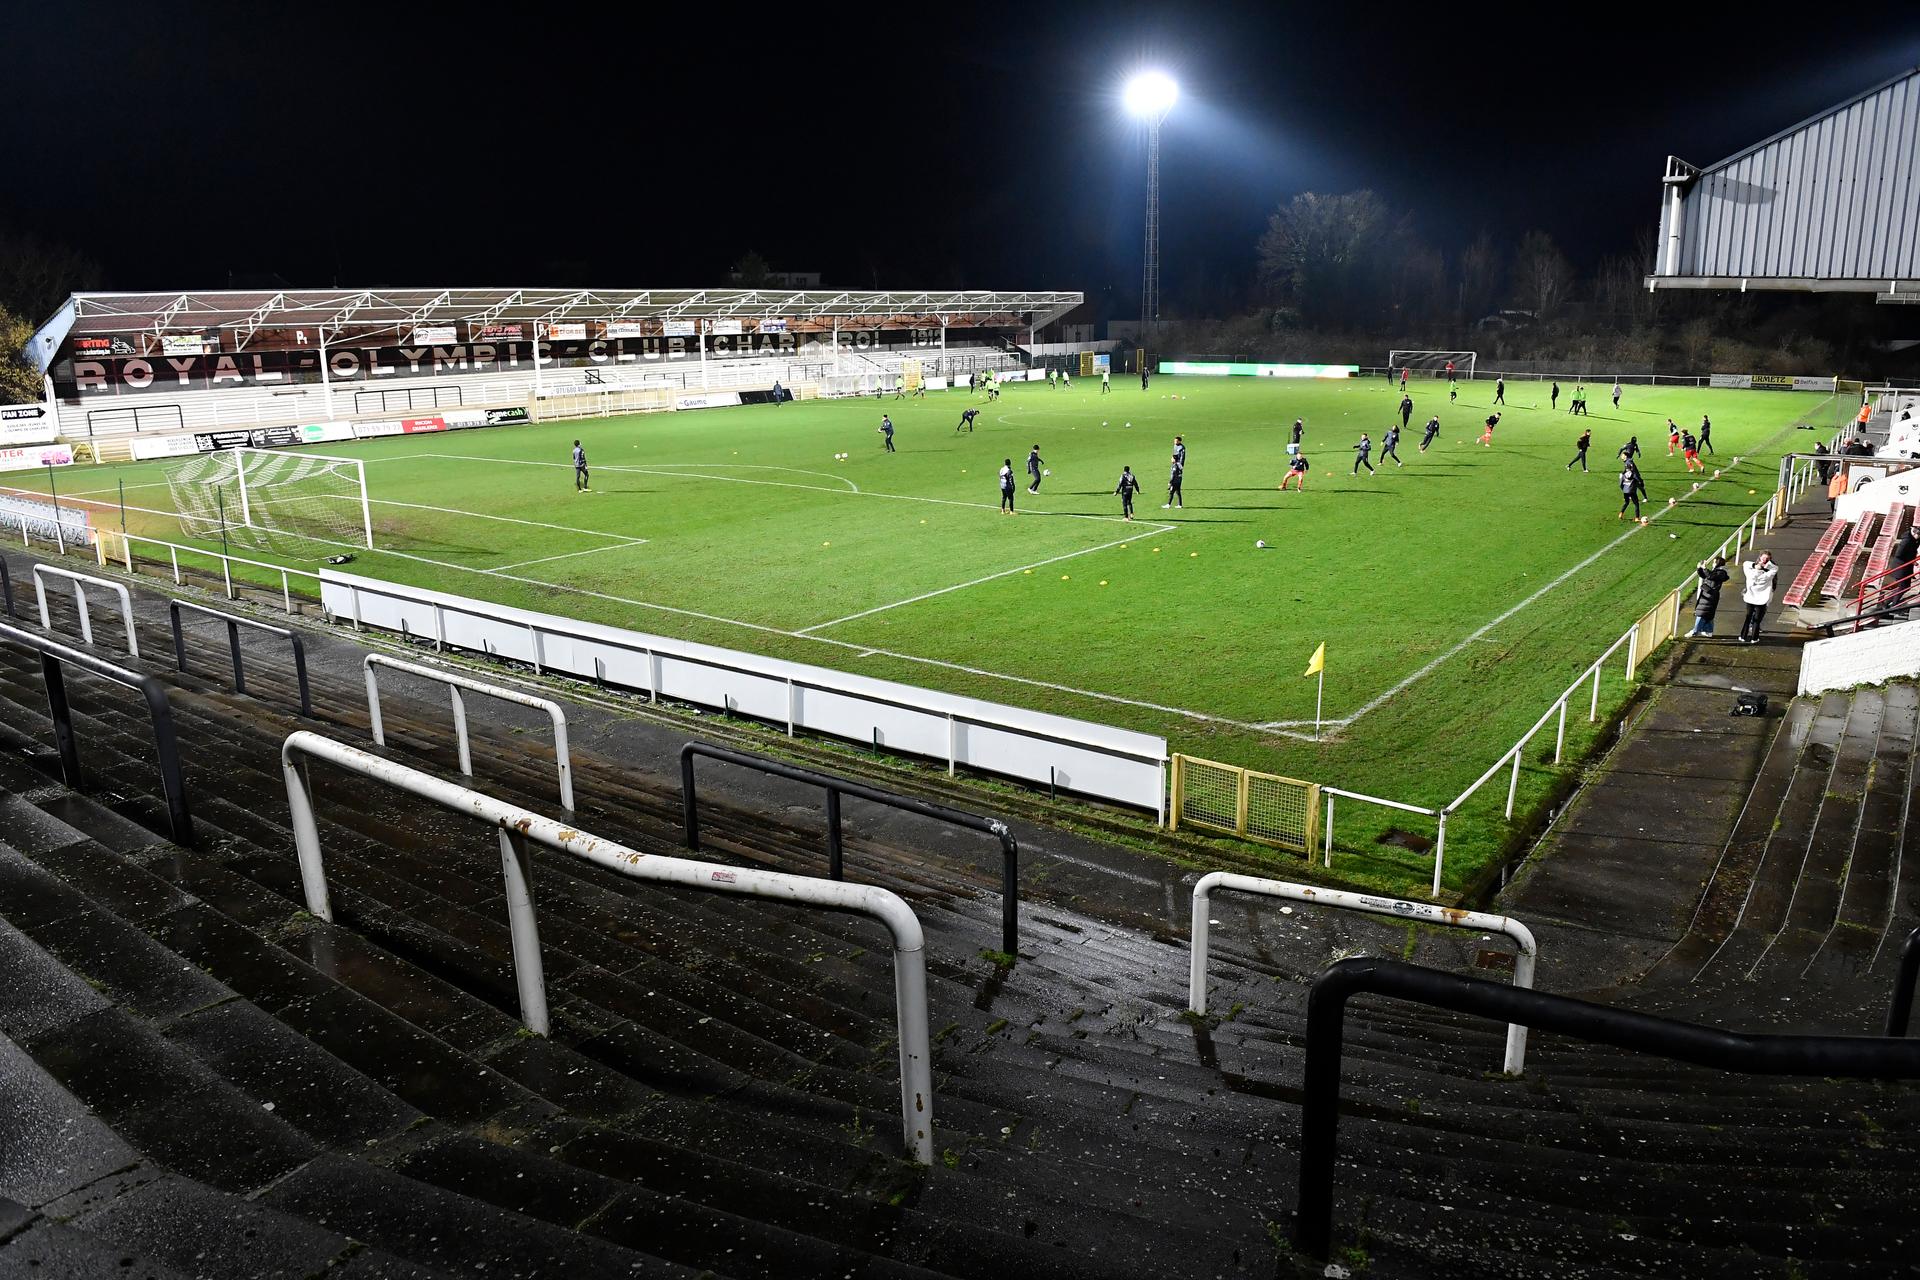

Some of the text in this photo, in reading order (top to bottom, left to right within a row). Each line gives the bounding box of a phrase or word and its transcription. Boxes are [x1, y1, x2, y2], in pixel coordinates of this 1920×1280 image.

[74, 355, 283, 391] ROYAL
[331, 342, 552, 376] OLYMPIC
[588, 337, 686, 362] CLUB
[713, 331, 880, 355] CHARROI
[911, 330, 941, 346] 1912
[2, 409, 39, 418] FAN ZONE
[0, 449, 24, 458] TER
